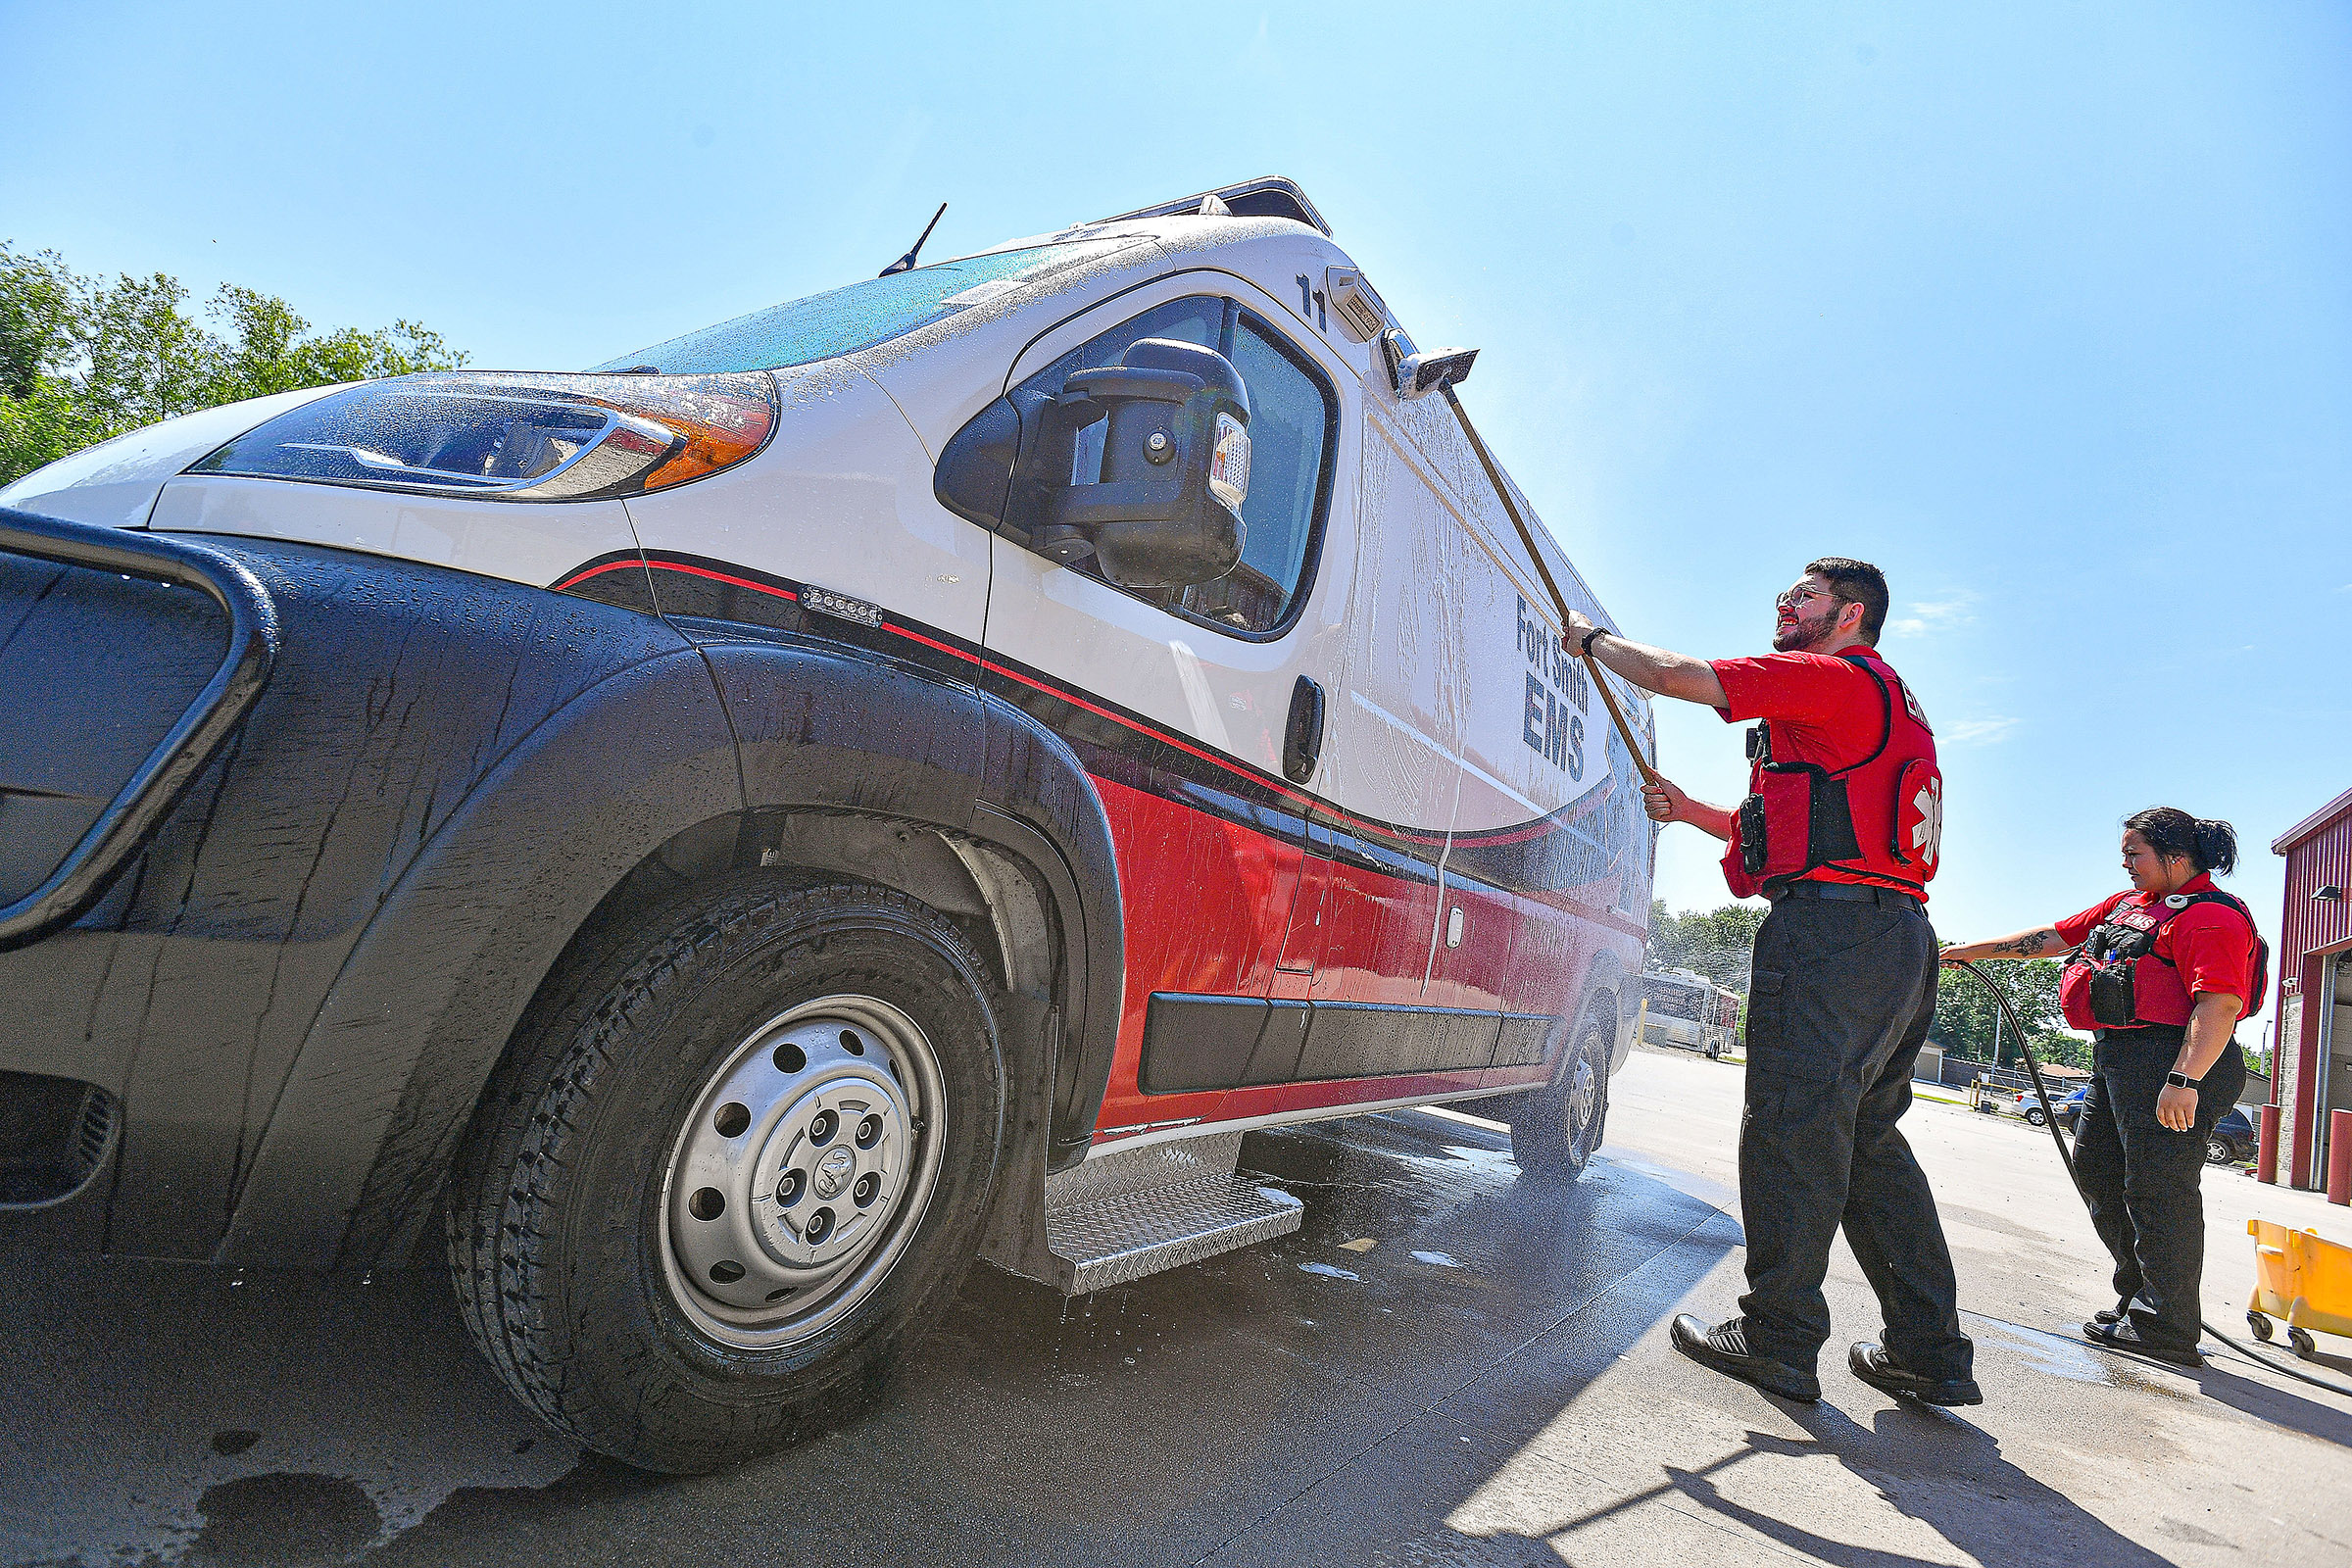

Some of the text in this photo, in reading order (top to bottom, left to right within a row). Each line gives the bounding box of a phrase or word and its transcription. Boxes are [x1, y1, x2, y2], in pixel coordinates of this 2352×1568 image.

[1295, 272, 1327, 334] 11
[1517, 593, 1589, 716] Fort Smith
[1523, 670, 1586, 783] EMS
[2125, 911, 2155, 929] EMS
